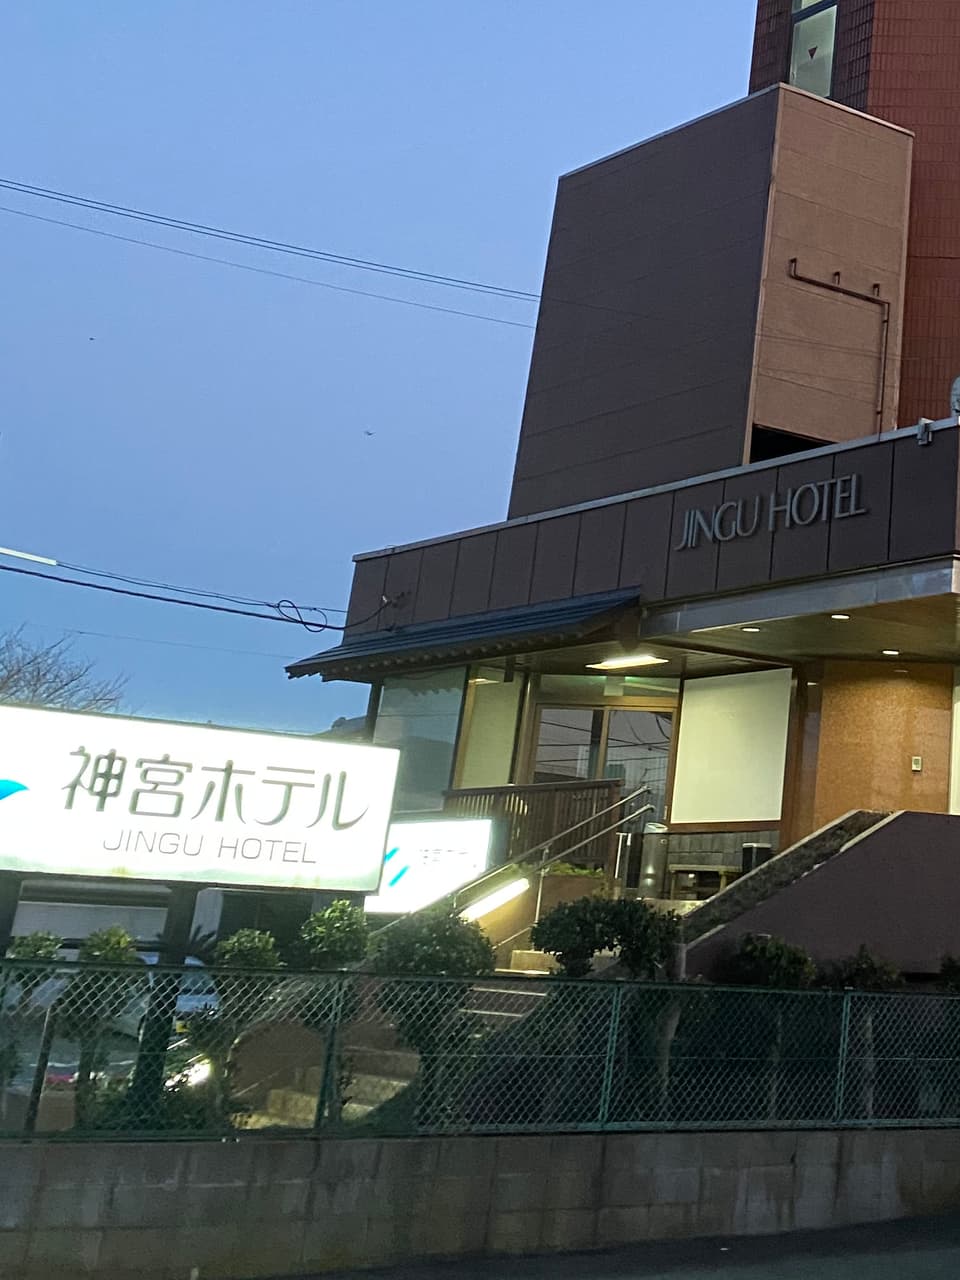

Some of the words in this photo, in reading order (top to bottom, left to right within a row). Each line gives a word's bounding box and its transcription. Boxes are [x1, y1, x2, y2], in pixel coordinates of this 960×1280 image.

[673, 495, 760, 551] JINGU
[768, 474, 866, 531] HOTEL
[62, 745, 369, 831] 神宮ホテル
[103, 829, 204, 857] JINGU
[218, 837, 317, 864] HOTEL
